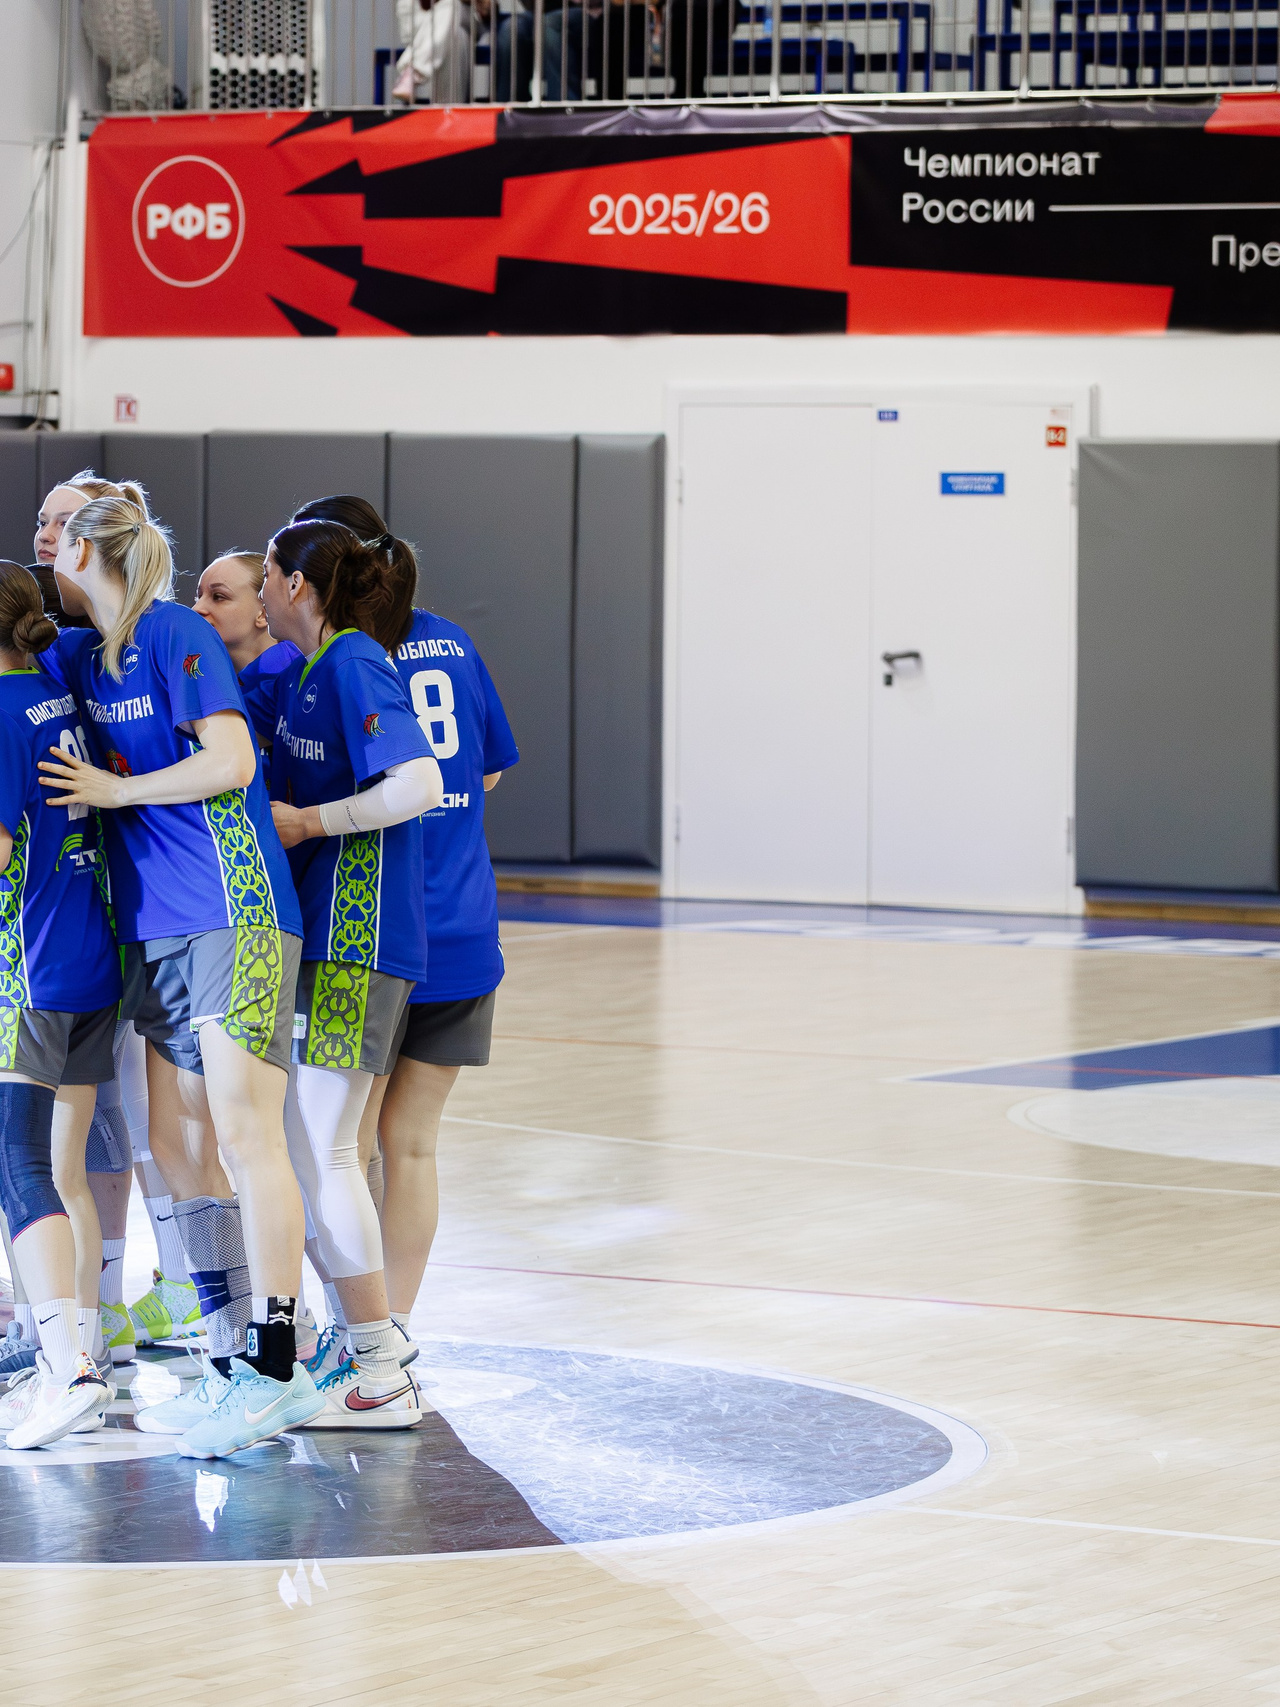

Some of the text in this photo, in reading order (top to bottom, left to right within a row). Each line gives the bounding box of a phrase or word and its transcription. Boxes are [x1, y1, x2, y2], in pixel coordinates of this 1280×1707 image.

[903, 147, 1101, 178] Чемпионат
[146, 203, 231, 240] РФБ
[588, 189, 770, 237] 2025/26
[902, 192, 1035, 223] России
[1212, 235, 1280, 272] Пре
[397, 639, 464, 660] ОБЛАСТЬ
